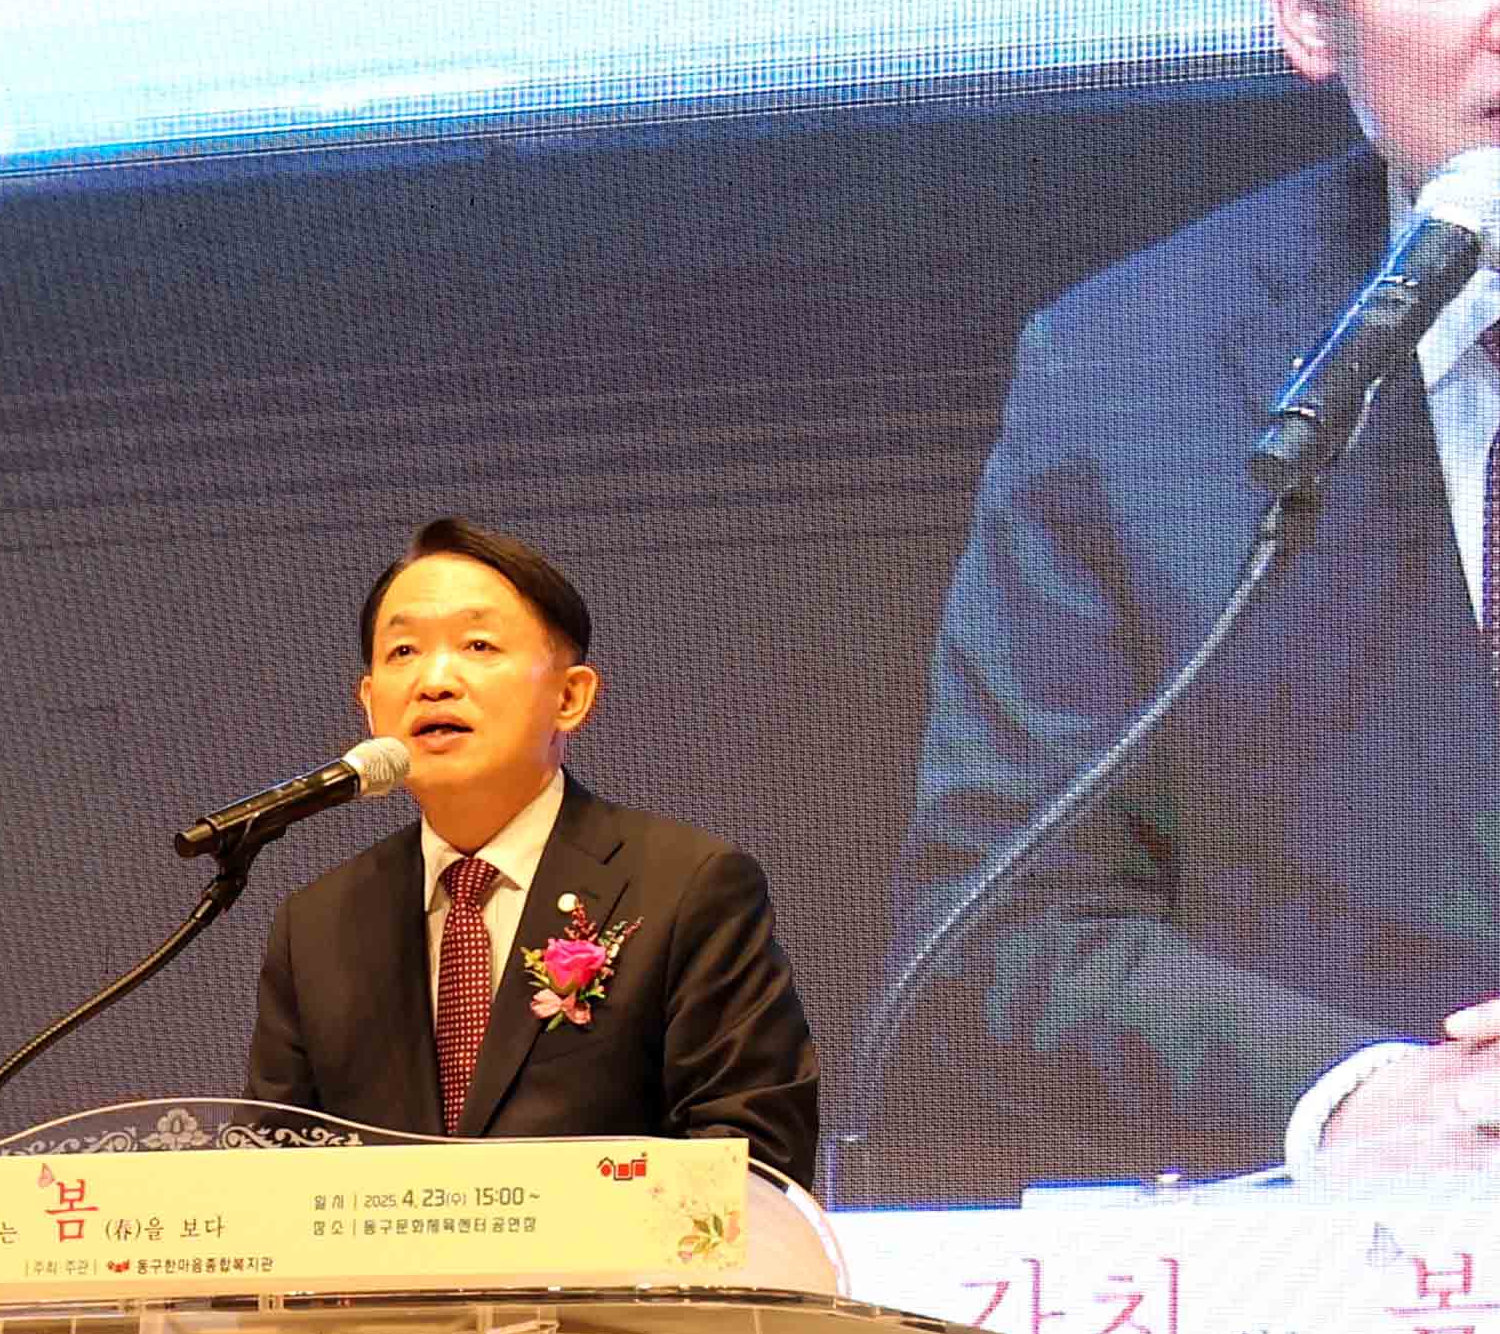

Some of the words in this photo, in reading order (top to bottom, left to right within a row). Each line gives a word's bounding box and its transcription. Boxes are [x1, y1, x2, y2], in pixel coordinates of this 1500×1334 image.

[475, 1187, 524, 1206] 15:00
[181, 1216, 226, 1239] 보다
[137, 1257, 274, 1274] 동구한마음종합복지관
